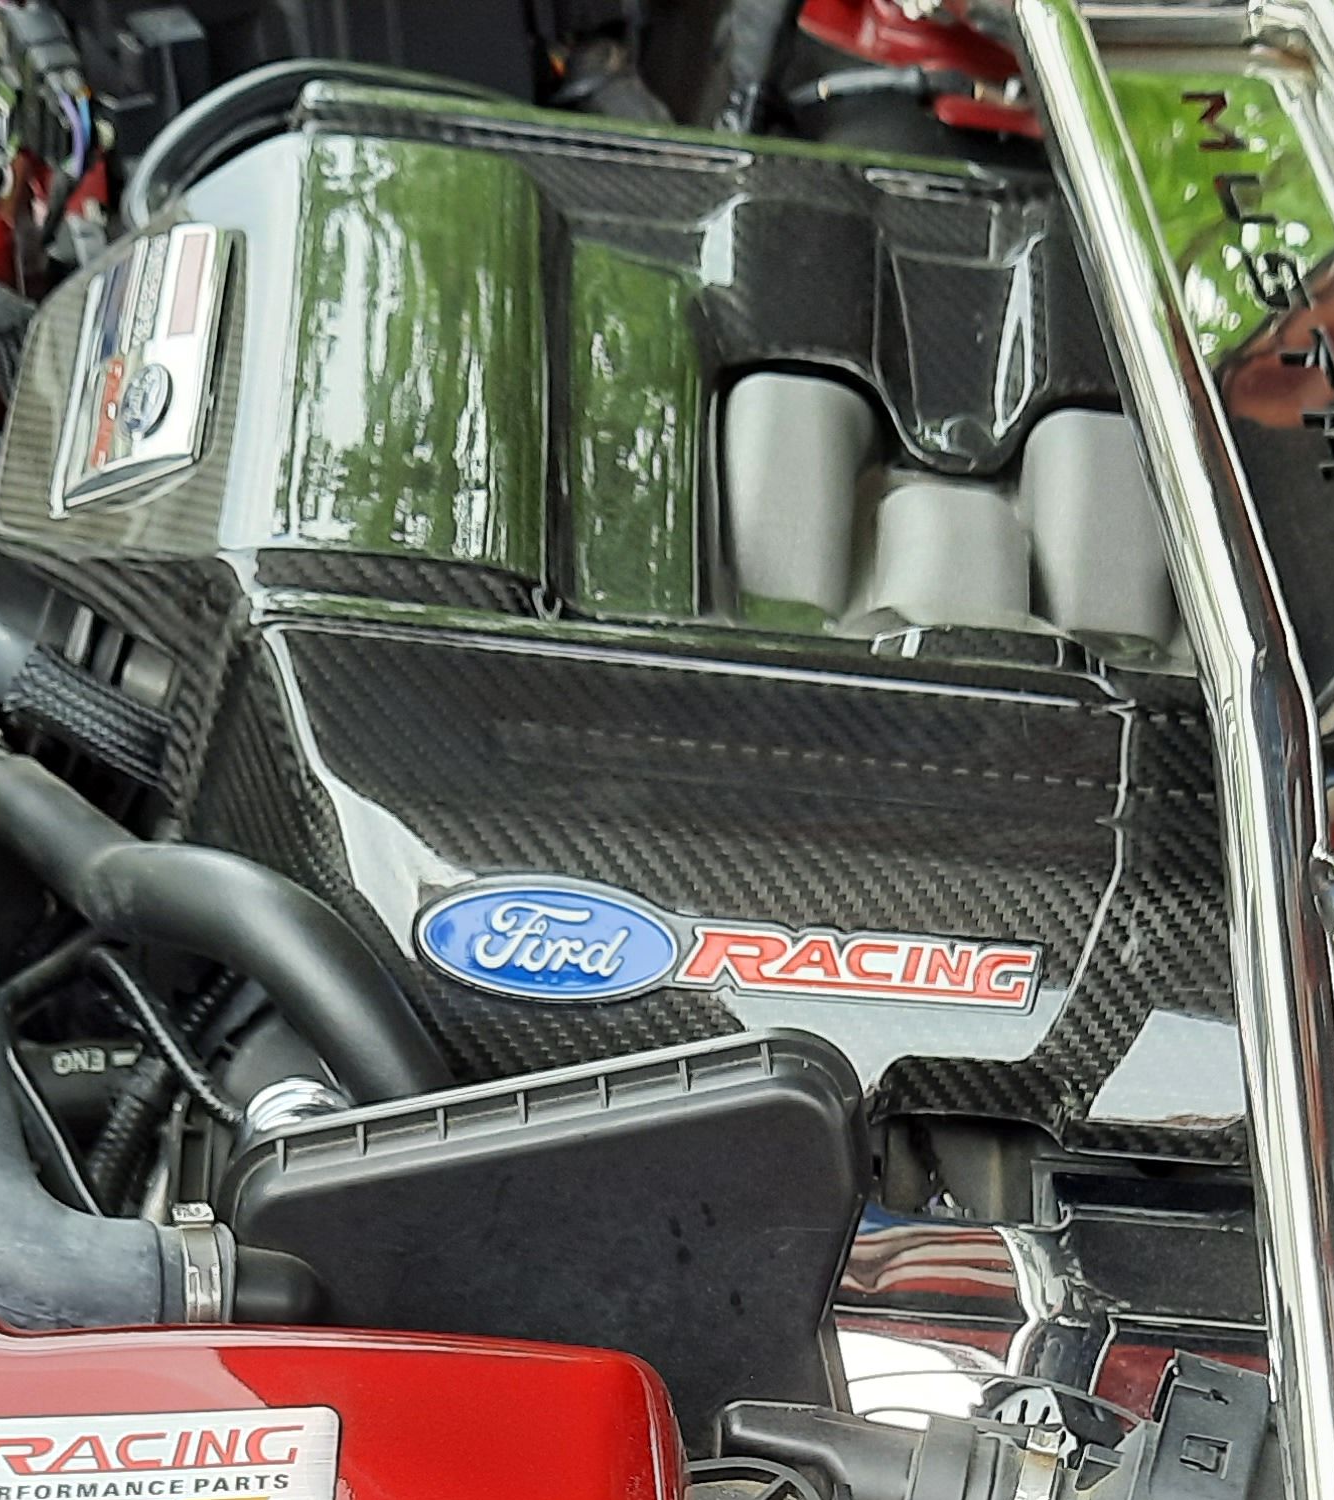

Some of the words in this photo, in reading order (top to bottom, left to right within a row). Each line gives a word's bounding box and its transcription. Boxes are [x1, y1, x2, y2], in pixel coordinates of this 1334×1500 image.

[475, 902, 624, 978] Ford
[676, 928, 1038, 1006] RACING
[193, 1473, 291, 1494] PARTS
